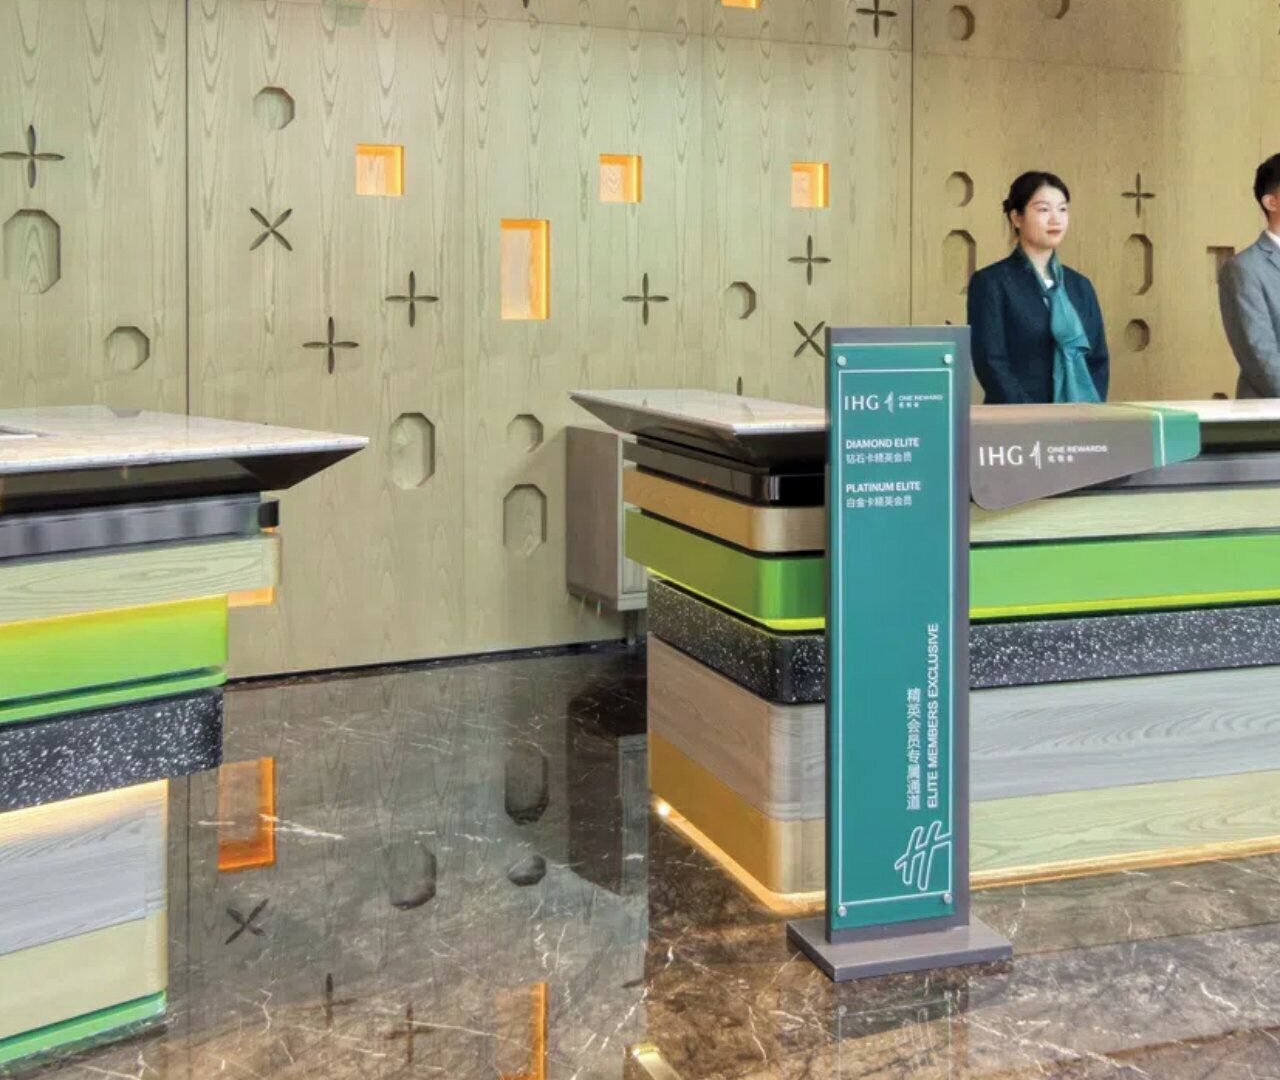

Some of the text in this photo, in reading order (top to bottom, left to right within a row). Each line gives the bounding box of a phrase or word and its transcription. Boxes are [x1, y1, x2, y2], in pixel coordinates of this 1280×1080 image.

[844, 394, 879, 411] IHG
[846, 437, 920, 449] DIAMOND ELITE
[1067, 445, 1108, 453] REWARDS
[846, 451, 912, 464] 钻石卡精英会员
[979, 445, 1024, 466] IHG
[846, 481, 921, 493] PLATINUM ELITE
[846, 495, 912, 508] 白金卡精英会员
[927, 623, 939, 808] ELITE MEMBERS EXCLUSIVE
